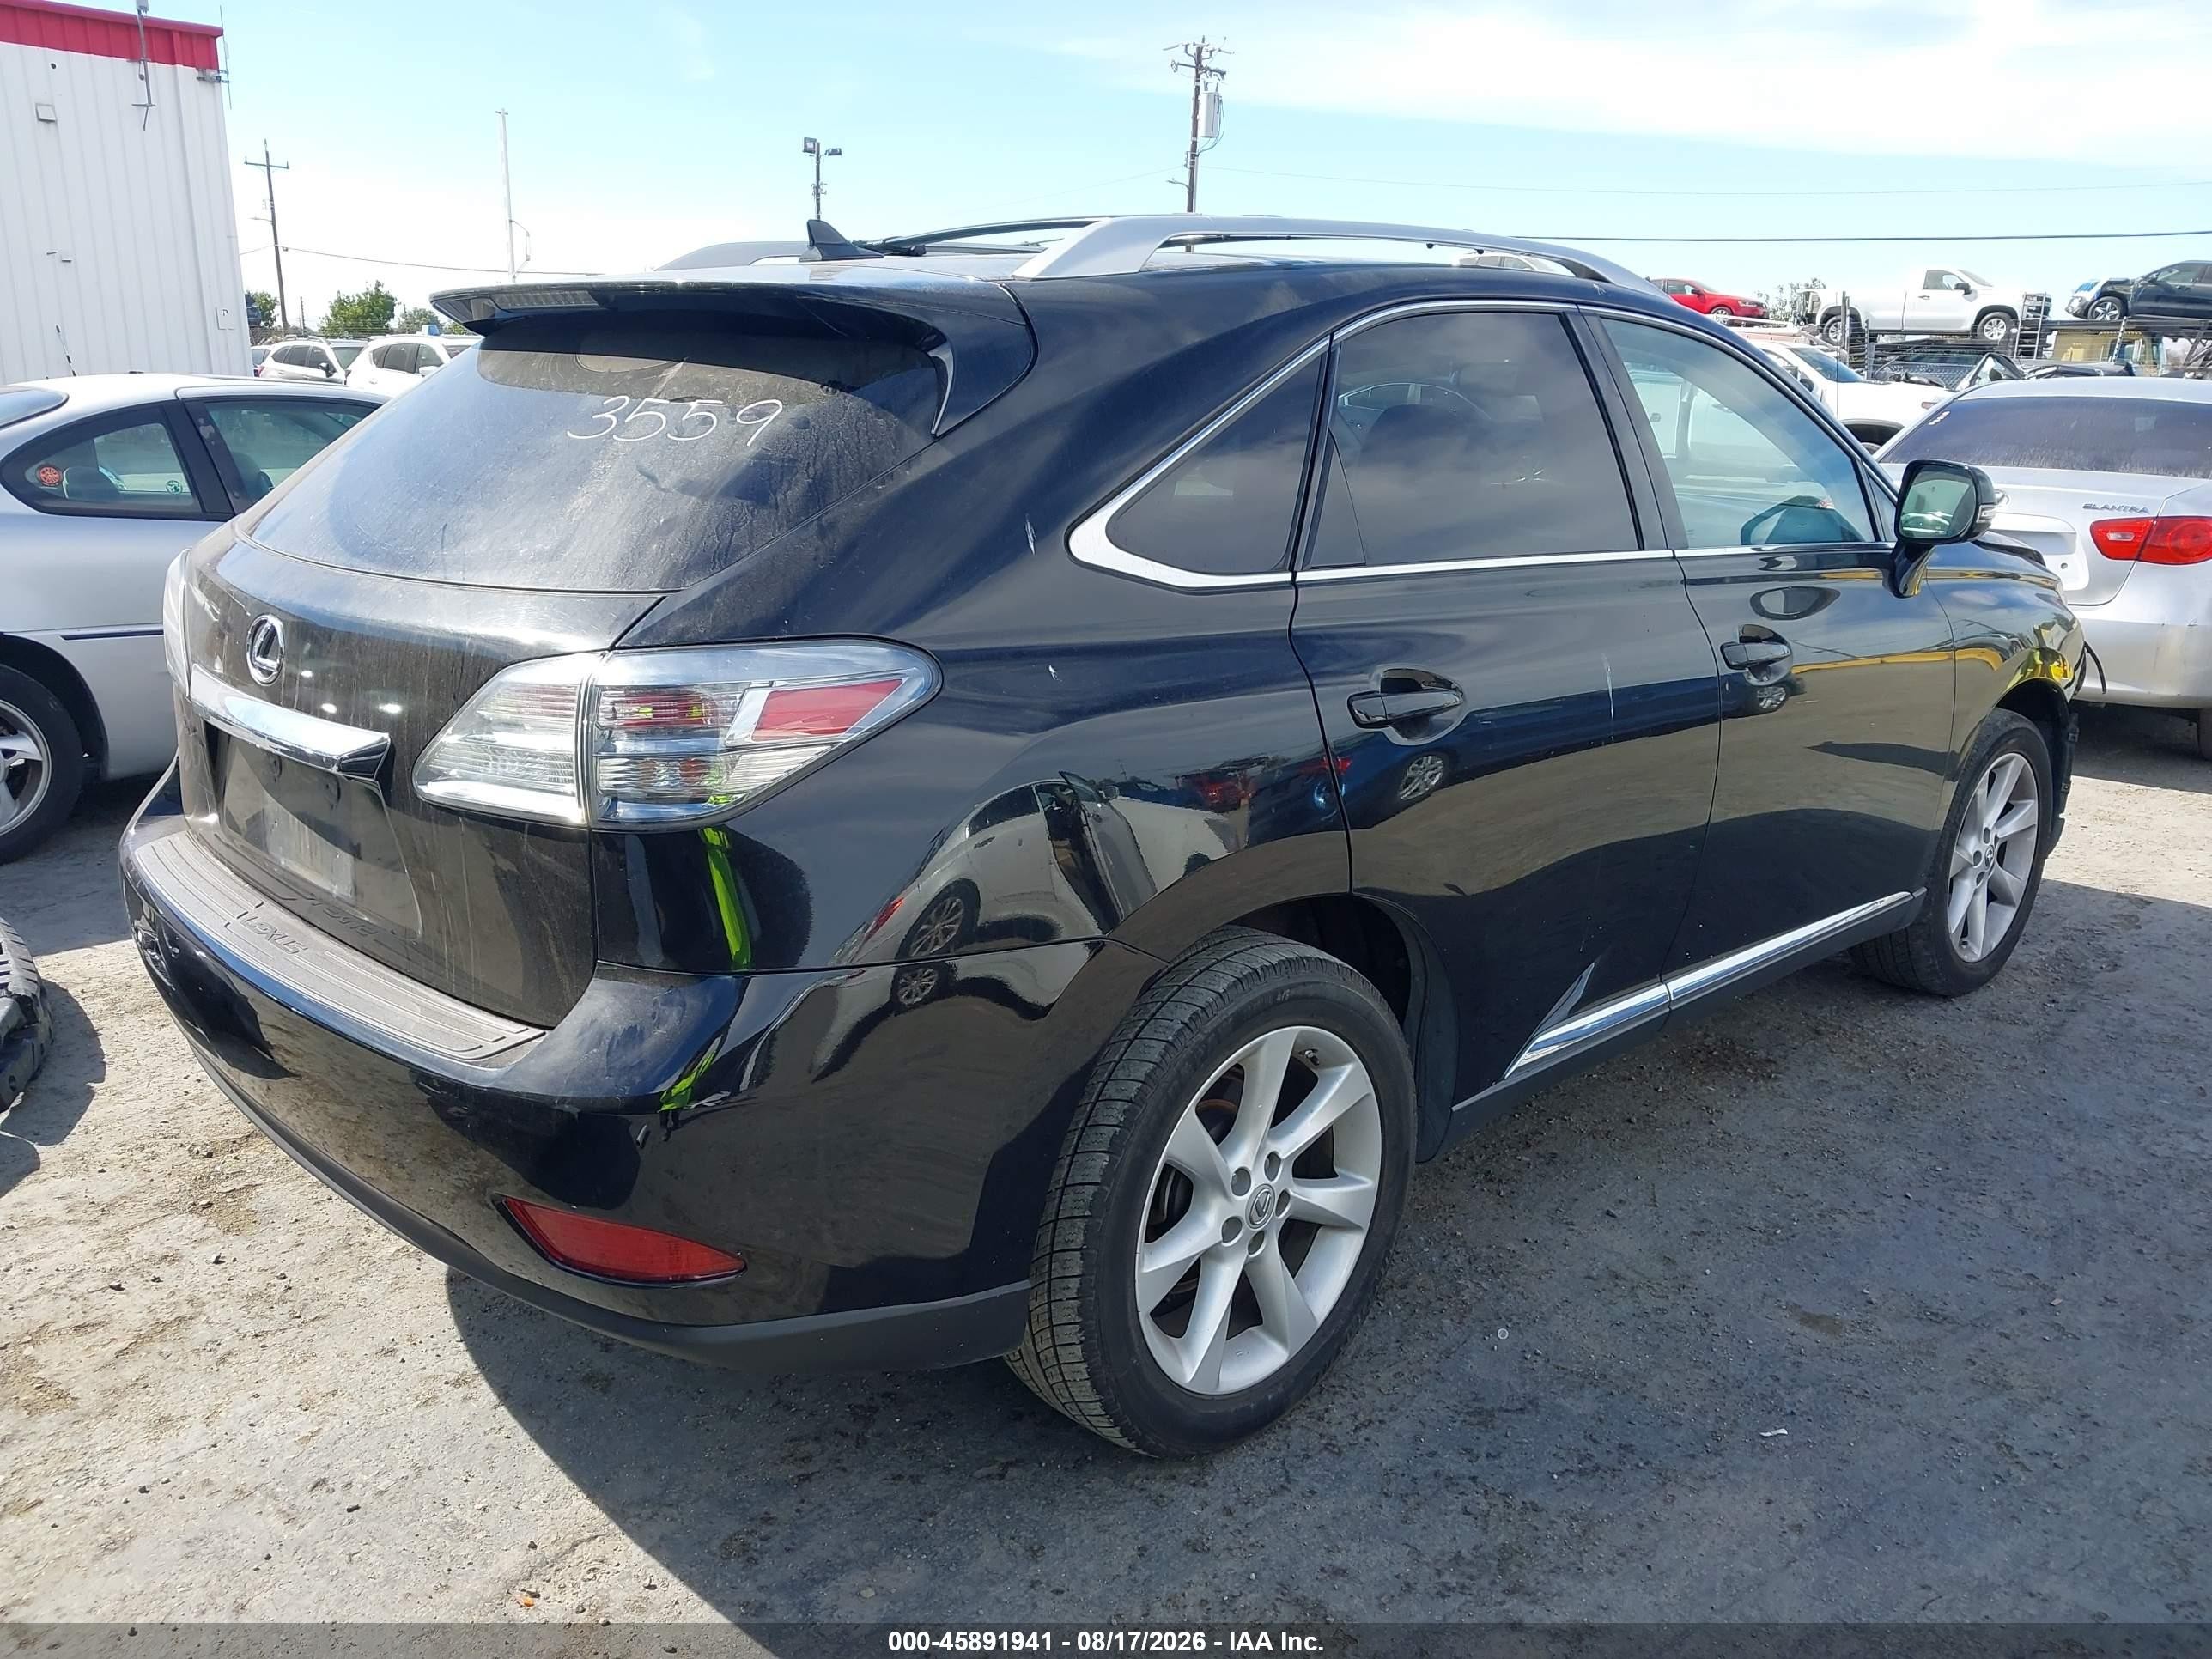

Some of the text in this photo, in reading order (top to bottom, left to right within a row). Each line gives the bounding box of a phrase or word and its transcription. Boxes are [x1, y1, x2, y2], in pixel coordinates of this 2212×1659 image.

[567, 395, 783, 447] 3559
[2082, 502, 2150, 515] ELANTRA
[241, 916, 308, 955] LEXUS
